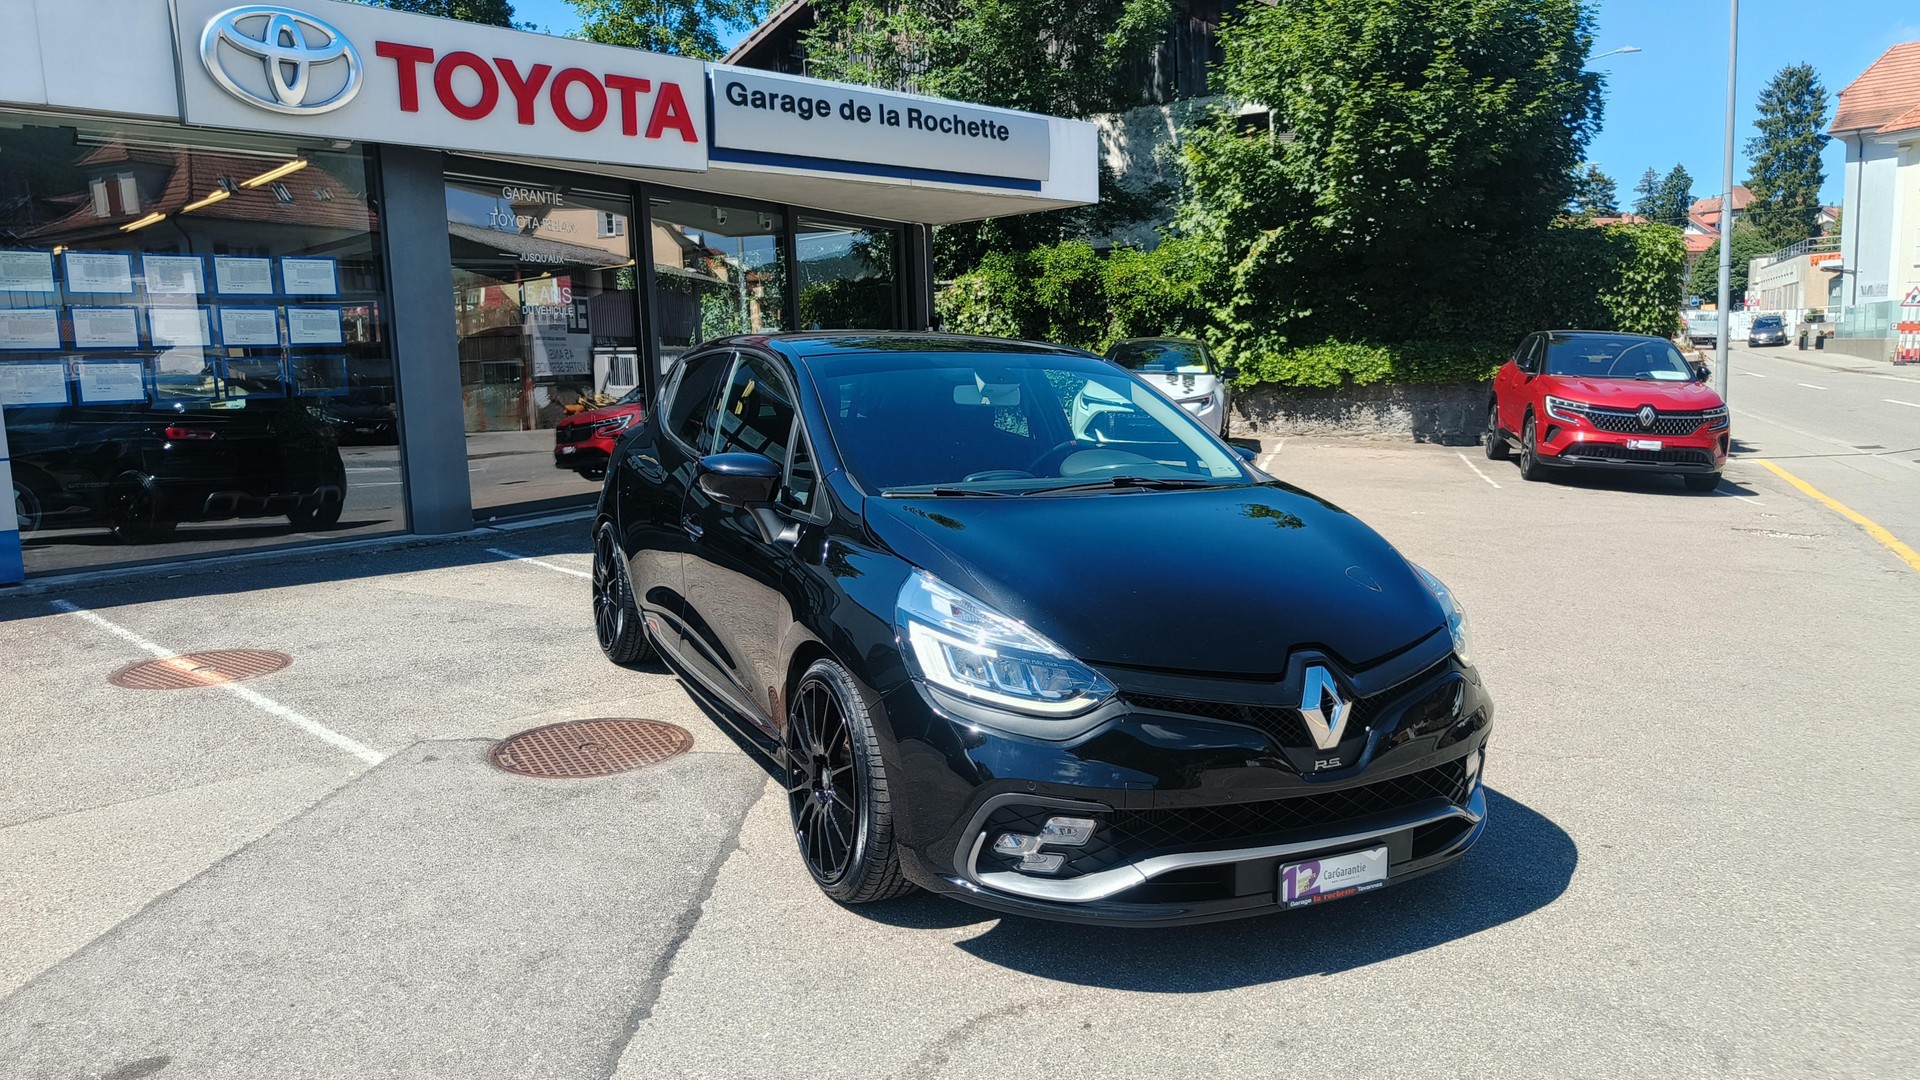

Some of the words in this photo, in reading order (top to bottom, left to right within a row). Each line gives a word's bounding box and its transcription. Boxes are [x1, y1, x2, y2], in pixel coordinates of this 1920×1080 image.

[376, 41, 698, 143] TOYOTA
[726, 82, 831, 120] Garage
[839, 99, 871, 123] de
[879, 103, 900, 127] la
[907, 108, 1009, 141] Rochette
[502, 186, 563, 206] GARANTIE
[490, 212, 540, 230] TOYOTA
[519, 252, 565, 264] JUSQU'AUX
[540, 286, 573, 304] ANS
[1283, 860, 1321, 899] 12
[1323, 863, 1367, 880] CarGarantie
